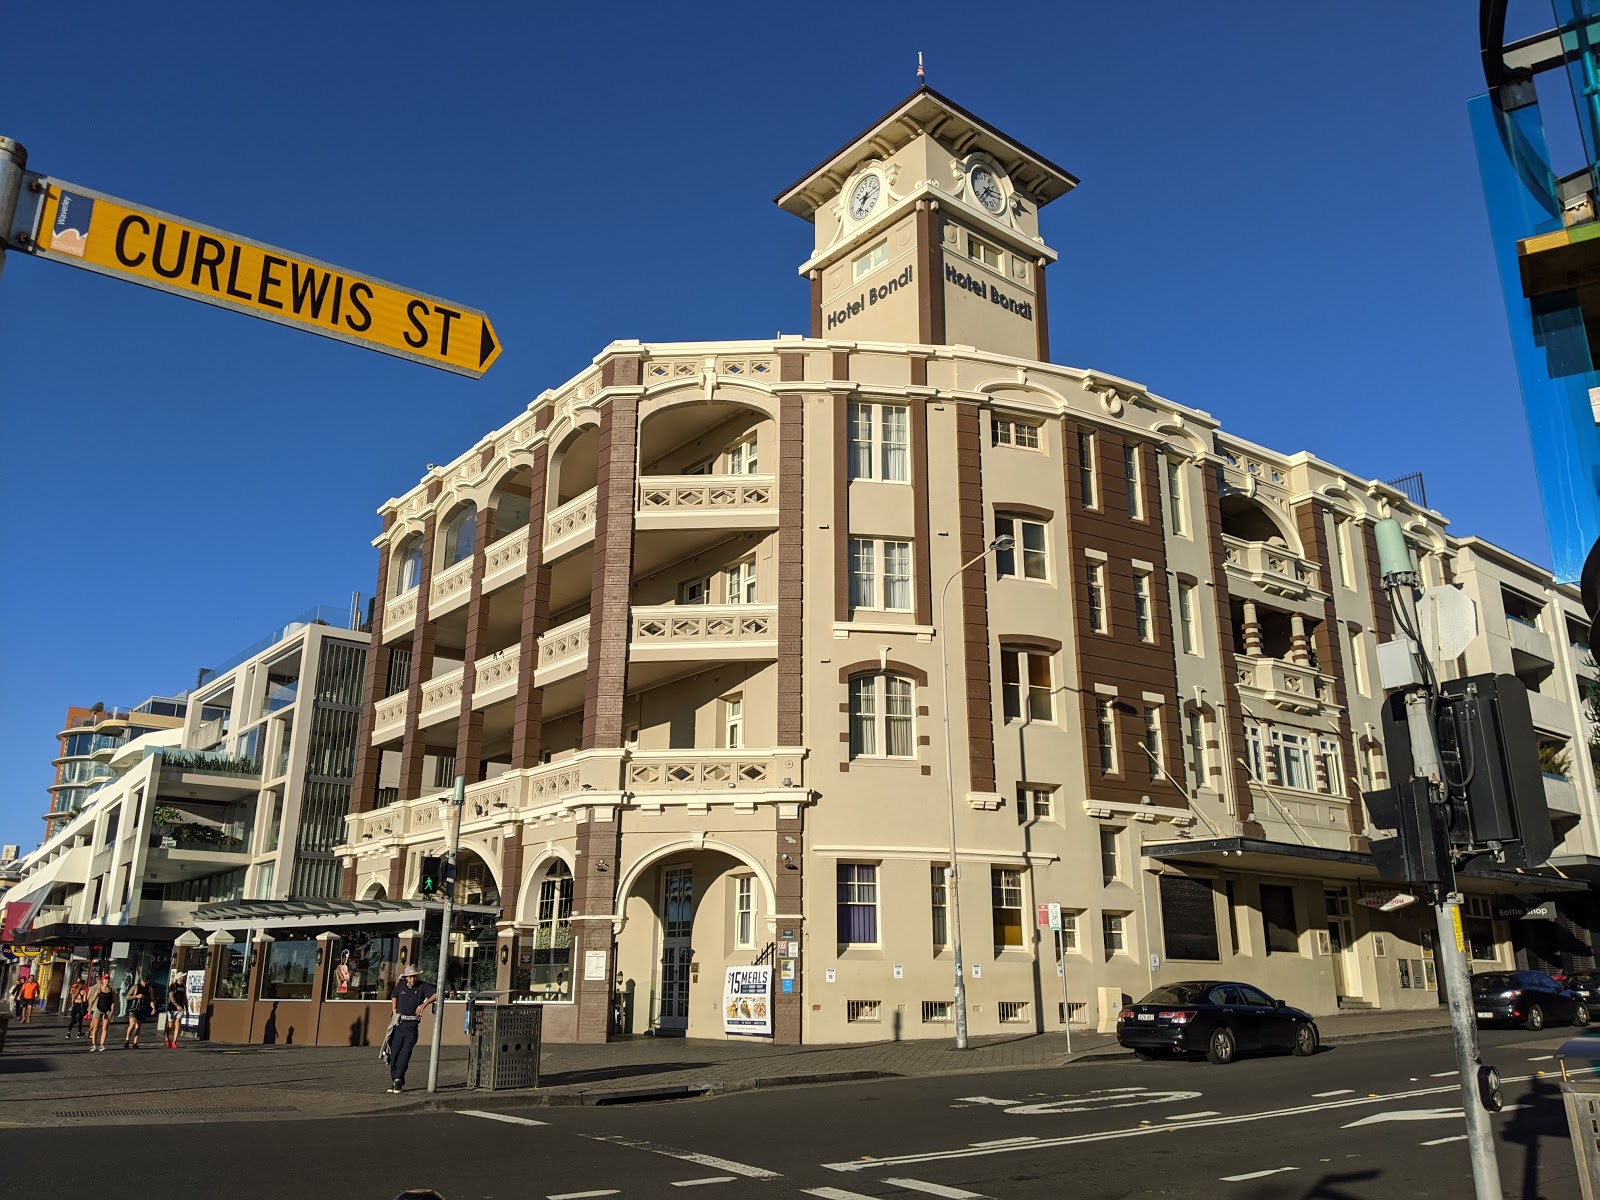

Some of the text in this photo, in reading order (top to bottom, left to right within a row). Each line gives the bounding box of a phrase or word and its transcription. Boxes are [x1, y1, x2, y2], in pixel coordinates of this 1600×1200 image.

[57, 195, 72, 225] Waverley
[53, 241, 83, 253] Council
[115, 214, 461, 355] CURLEWIS ST
[945, 262, 1033, 321] Hotel Bondi
[827, 264, 913, 331] Hotel Bondi
[1499, 906, 1548, 916] Bottle Shop
[69, 925, 88, 934] 178
[741, 971, 768, 984] MEALS
